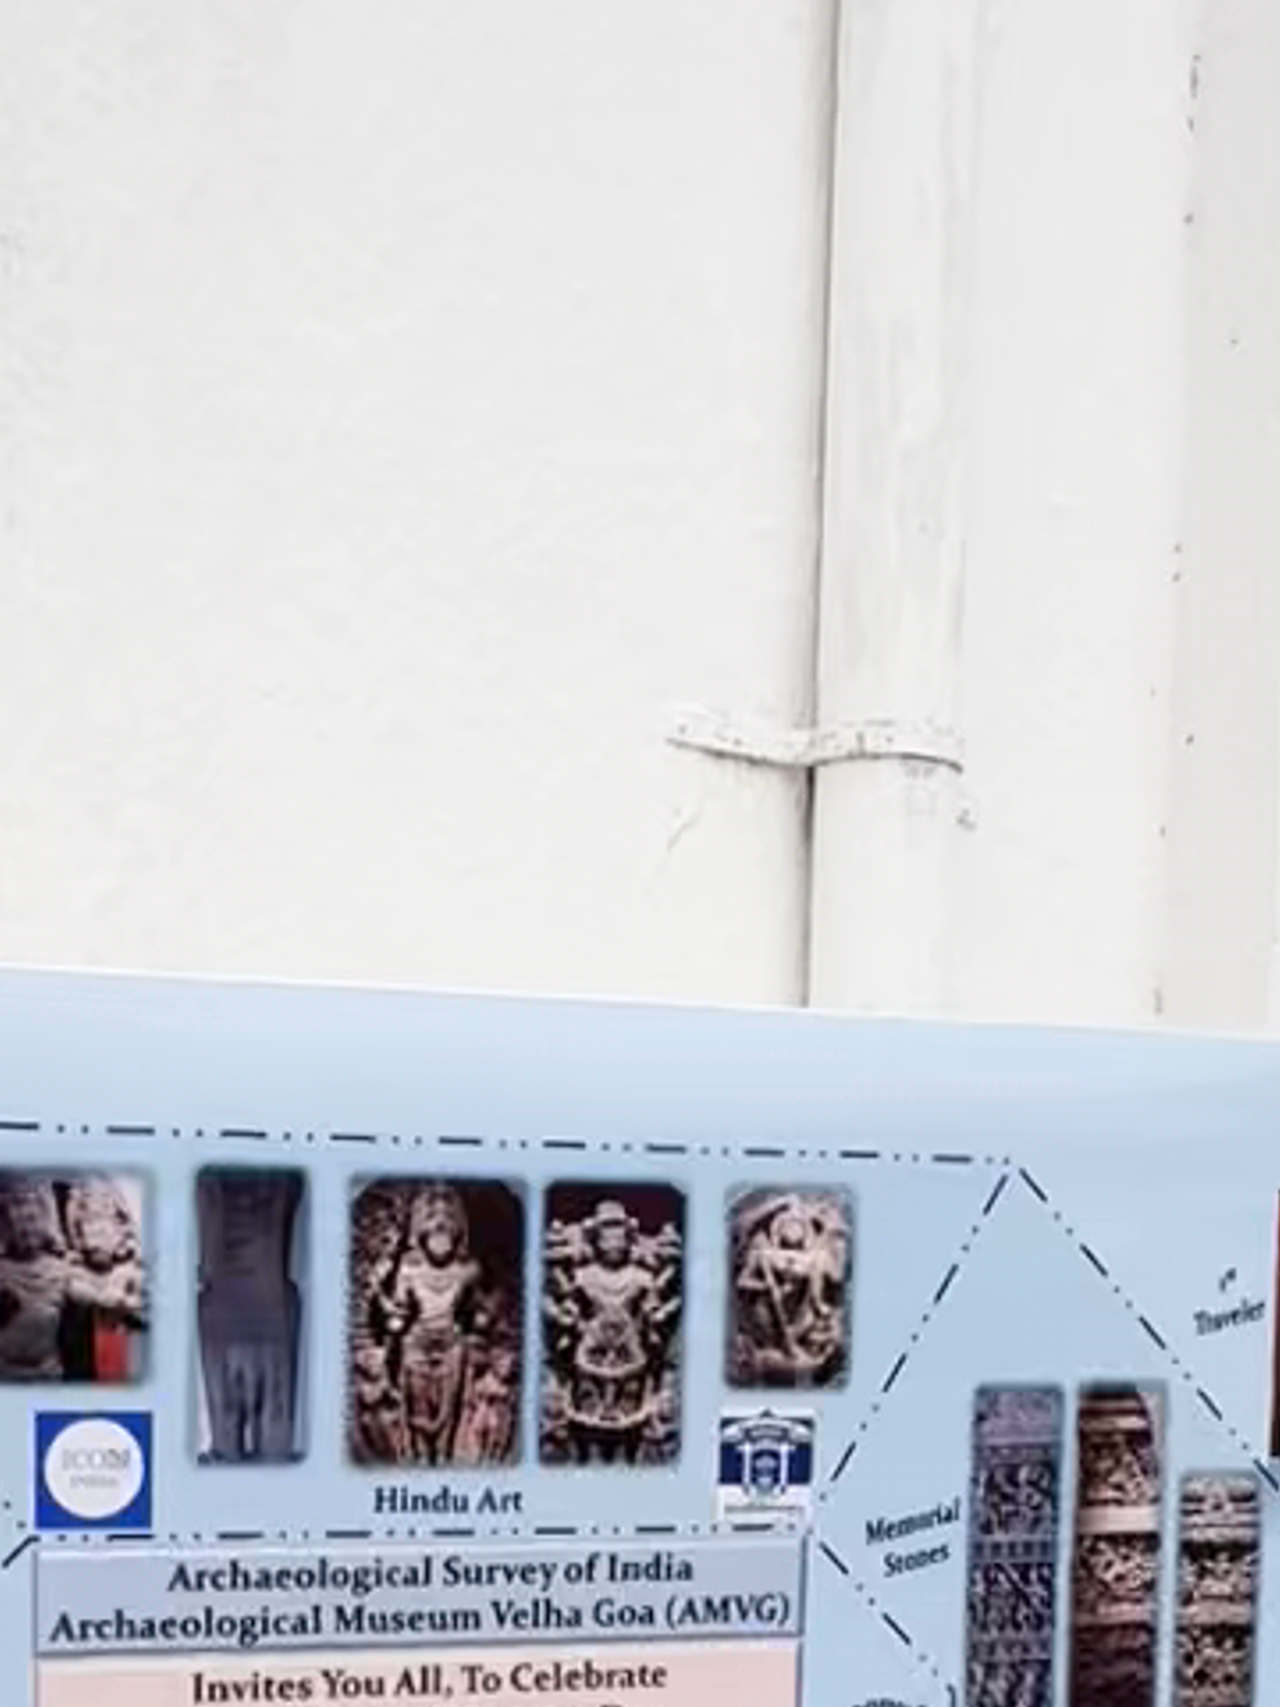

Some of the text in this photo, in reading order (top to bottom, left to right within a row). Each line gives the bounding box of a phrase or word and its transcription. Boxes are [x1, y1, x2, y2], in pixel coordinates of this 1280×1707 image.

[374, 1485, 523, 1513] Hindu Art
[167, 1552, 693, 1594] Archaeological Survey of India
[50, 1593, 790, 1647] Archaeological Museum Velha Goa (AMVG)
[193, 1659, 667, 1704] Invites You All, To Celebrate
